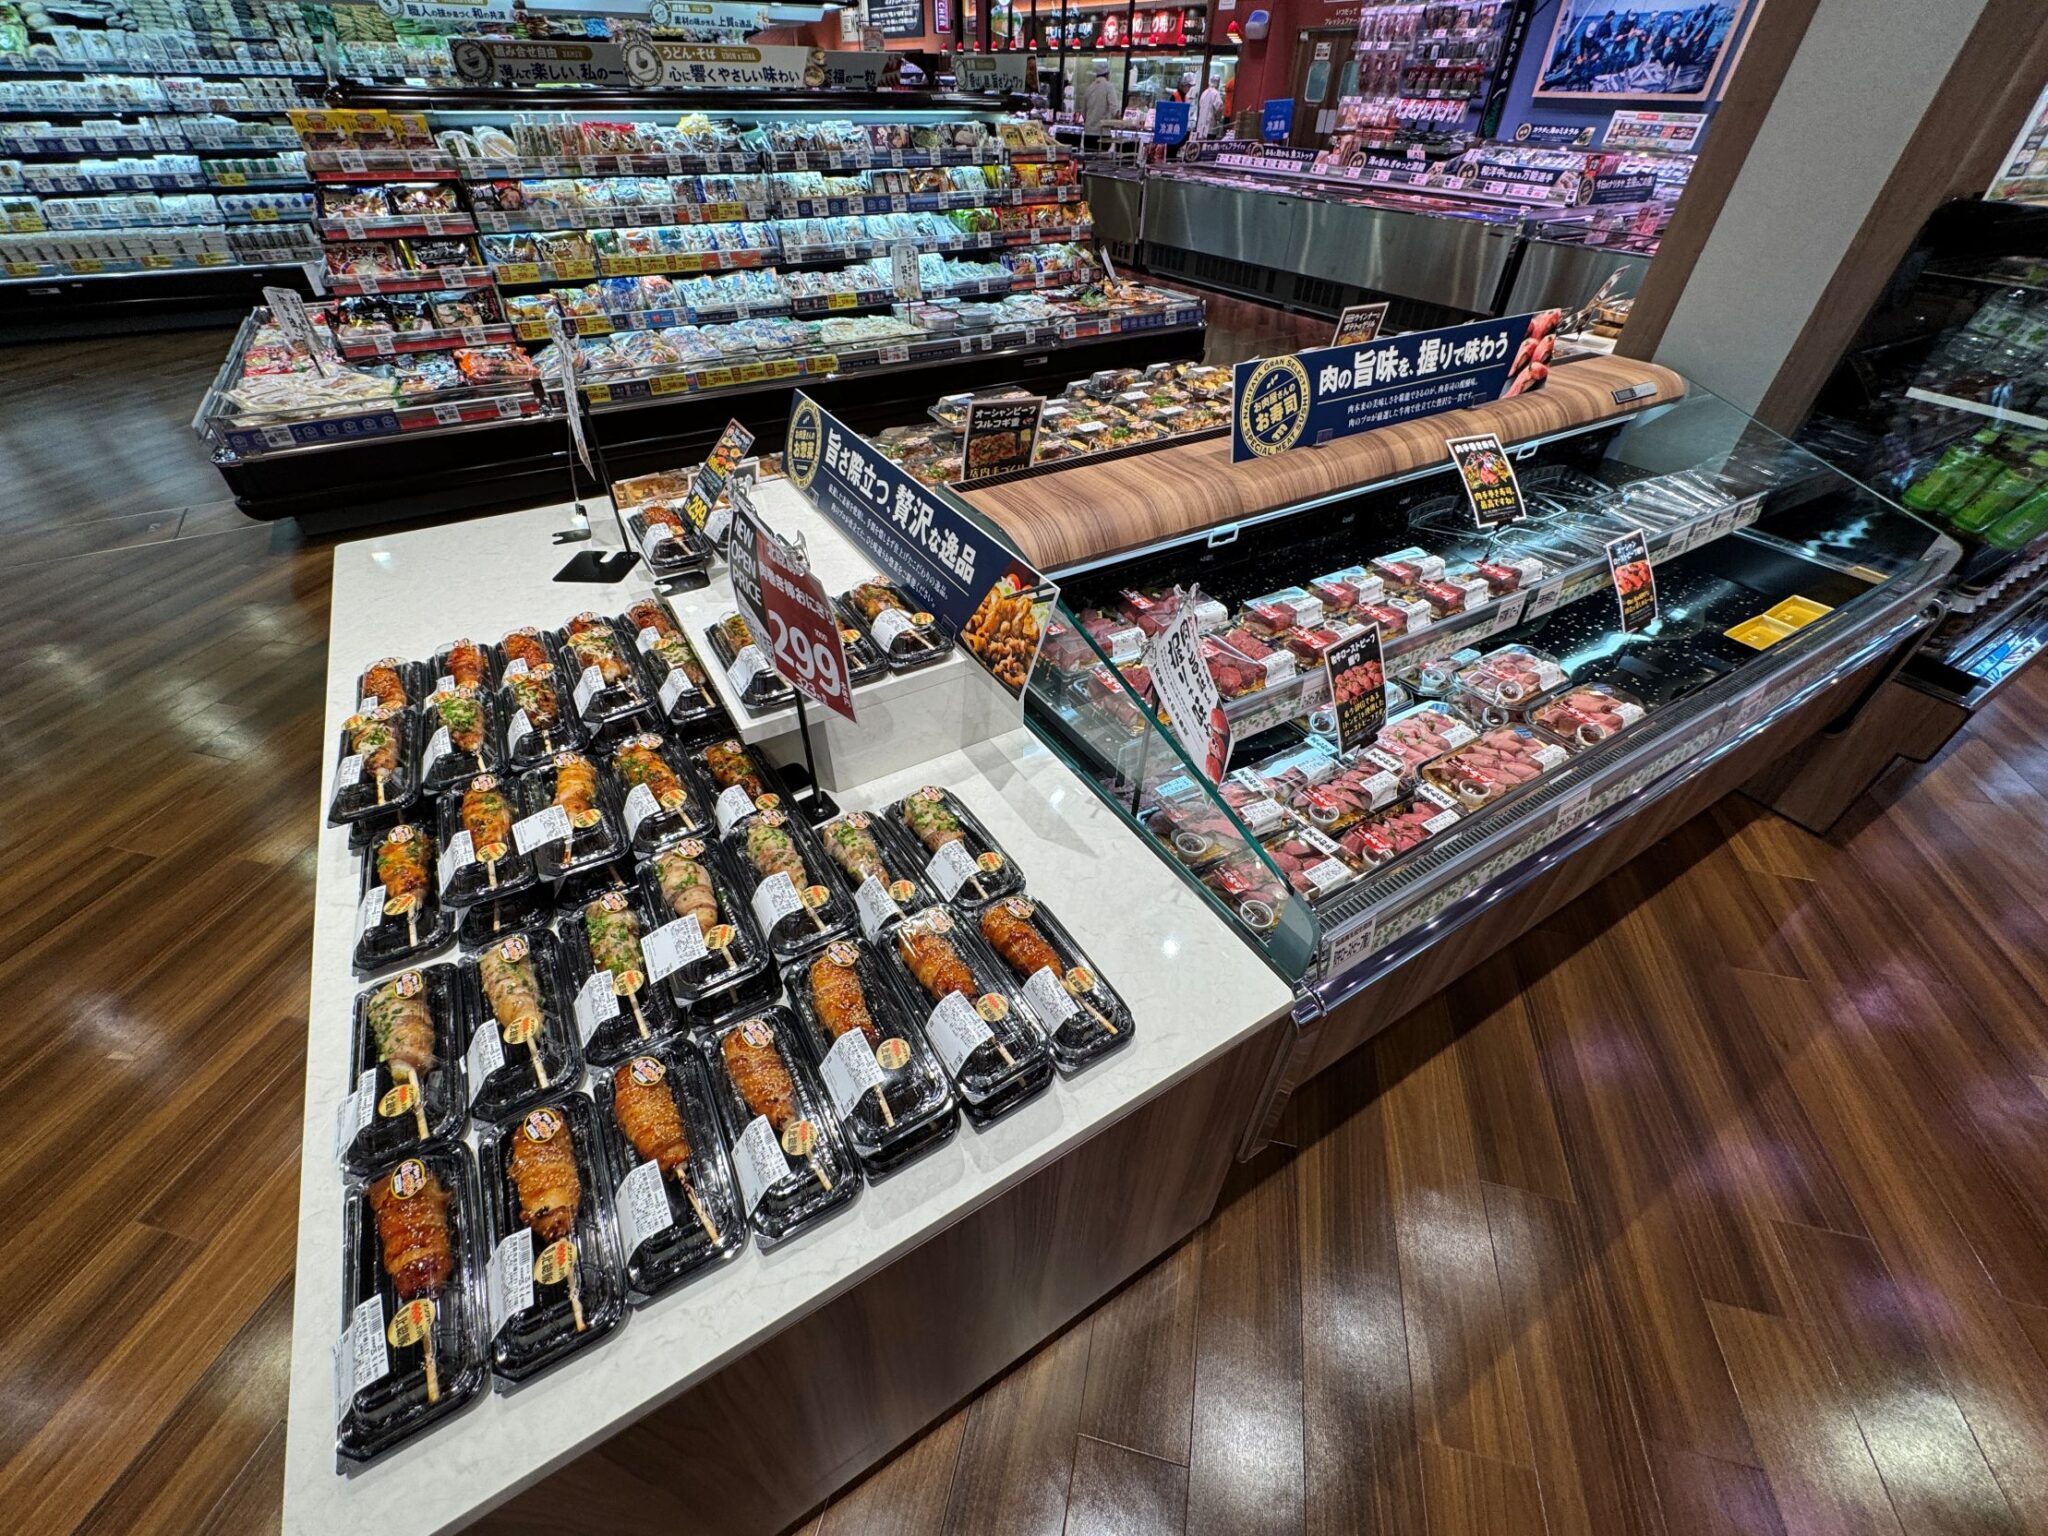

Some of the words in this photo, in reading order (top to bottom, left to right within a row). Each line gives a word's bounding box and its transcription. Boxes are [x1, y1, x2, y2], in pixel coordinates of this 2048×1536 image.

[661, 46, 717, 60] うどん・そば
[669, 64, 800, 84] 心に響くやさしい味わい
[1318, 331, 1509, 396] 肉の旨味を、握りで味わう
[975, 405, 1037, 419] オーシャンビーフ
[1255, 392, 1299, 432] お寿司
[824, 427, 978, 585] 旨さ際立つ、贅沢な逸品
[734, 513, 755, 550] NEW
[730, 539, 757, 580] OPEN
[732, 565, 763, 607] PRICE
[767, 608, 841, 698] 299
